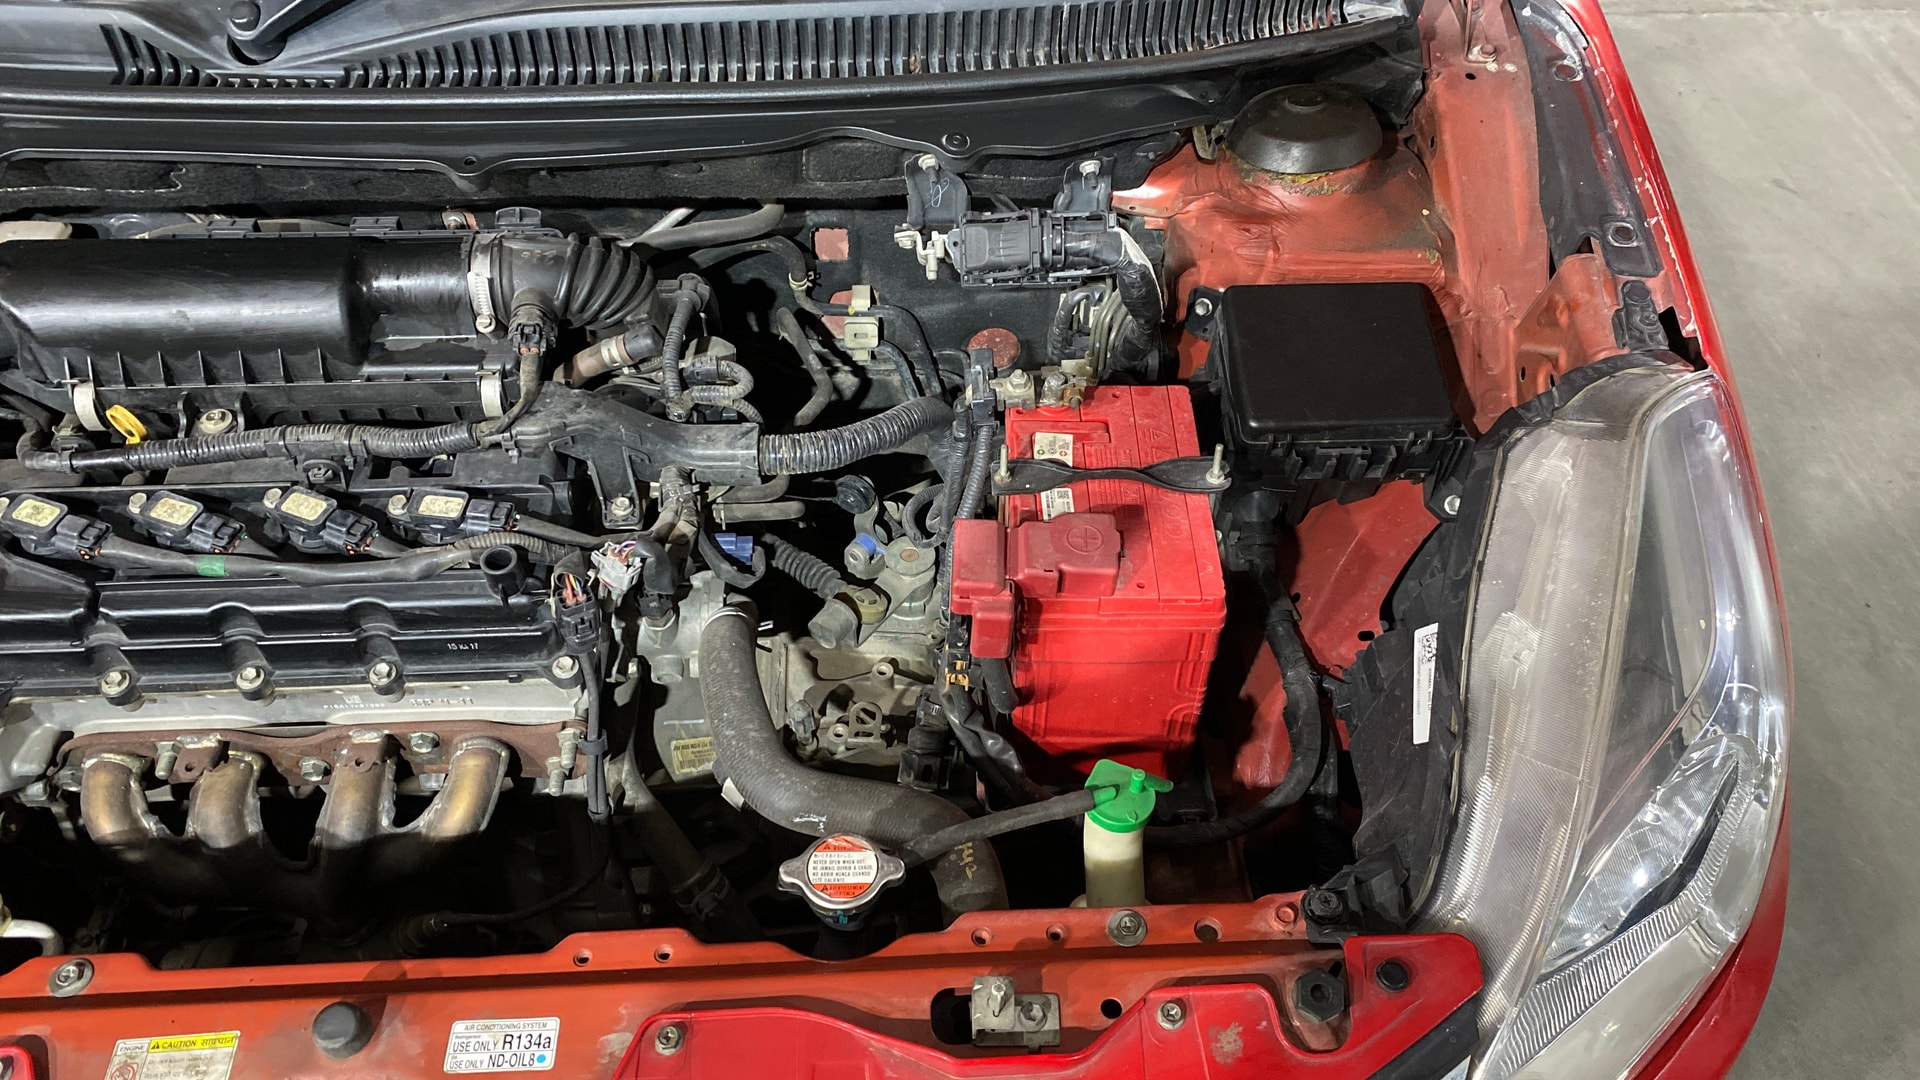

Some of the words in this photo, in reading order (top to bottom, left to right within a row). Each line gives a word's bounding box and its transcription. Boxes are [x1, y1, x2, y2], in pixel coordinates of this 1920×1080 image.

[464, 1023, 475, 1031] AIR
[476, 1023, 521, 1031] CONDITIONING
[162, 1040, 197, 1049] CAUTION
[452, 1041, 471, 1053] USE
[473, 1040, 499, 1052] ONLY
[502, 1033, 552, 1050] R134a
[449, 1061, 463, 1070] USE
[464, 1060, 485, 1069] ONLY
[487, 1053, 535, 1068] ND-OIL8
